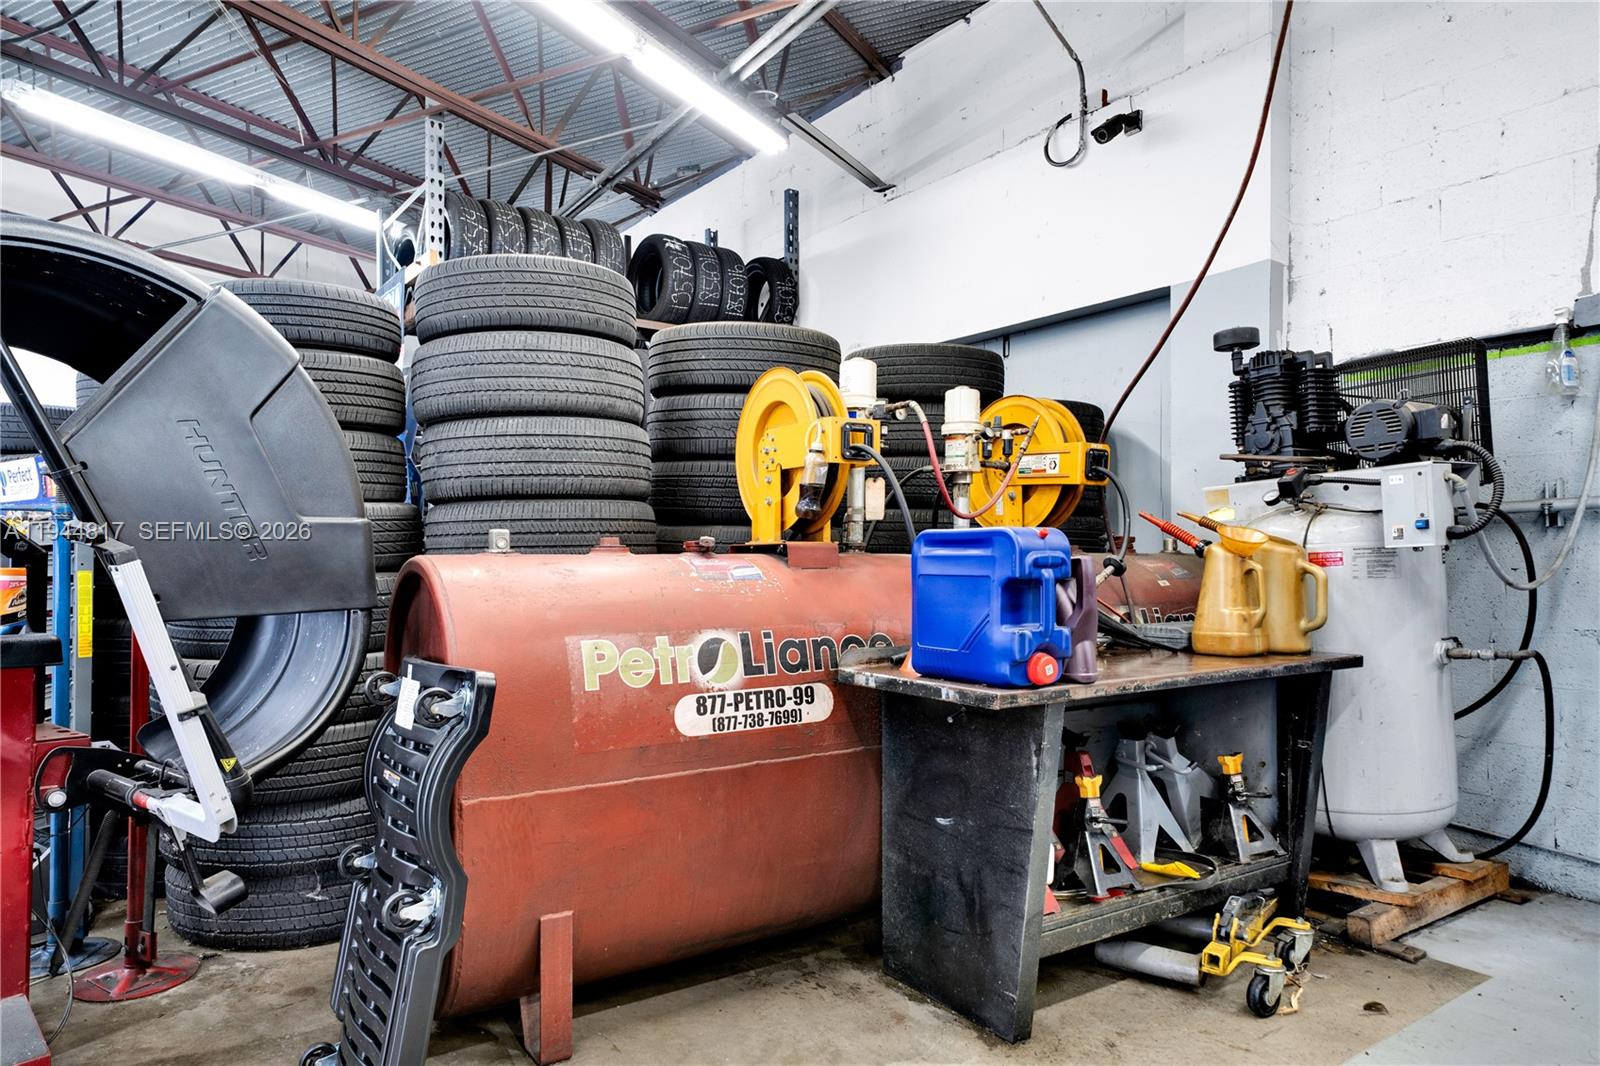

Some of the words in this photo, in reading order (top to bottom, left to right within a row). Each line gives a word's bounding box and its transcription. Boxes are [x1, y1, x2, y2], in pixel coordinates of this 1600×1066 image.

[7, 467, 33, 483] Perfect
[695, 685, 816, 717] 877-PETRO-99
[712, 708, 803, 733] (877-738-7699)
